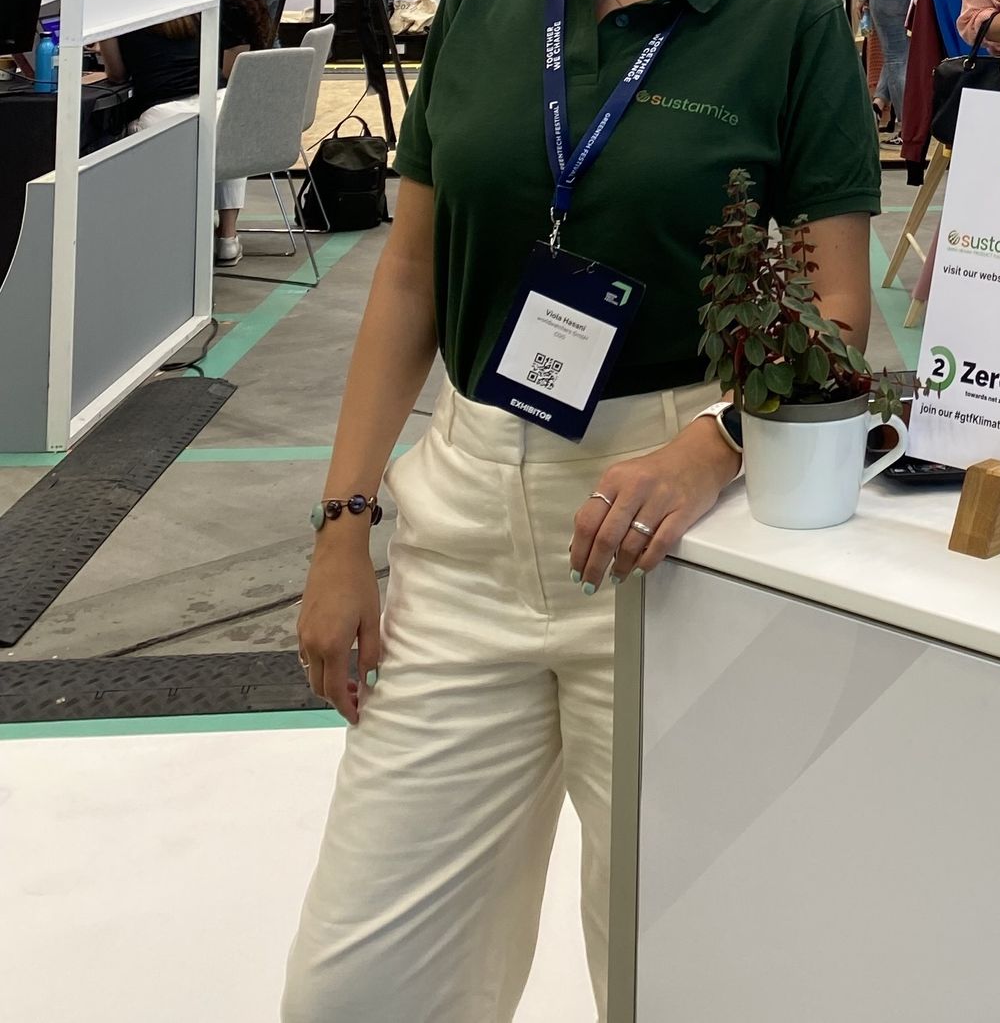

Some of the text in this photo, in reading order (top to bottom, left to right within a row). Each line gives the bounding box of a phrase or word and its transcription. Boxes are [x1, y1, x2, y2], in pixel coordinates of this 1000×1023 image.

[546, 26, 554, 69] TOGETHER
[554, 20, 562, 71] WE CHANGE
[623, 33, 661, 83] WE CHANGE
[633, 36, 664, 81] TOGETHER
[650, 92, 739, 126] sustamize
[553, 106, 565, 173] REENTECH FESTIVAL
[943, 265, 961, 275] visit
[963, 269, 978, 278] our
[546, 309, 562, 321] Viola
[932, 358, 945, 376] 2
[510, 398, 552, 422] EXHIBITOR
[920, 403, 937, 414] join
[938, 407, 953, 418] our
[988, 395, 997, 403] net
